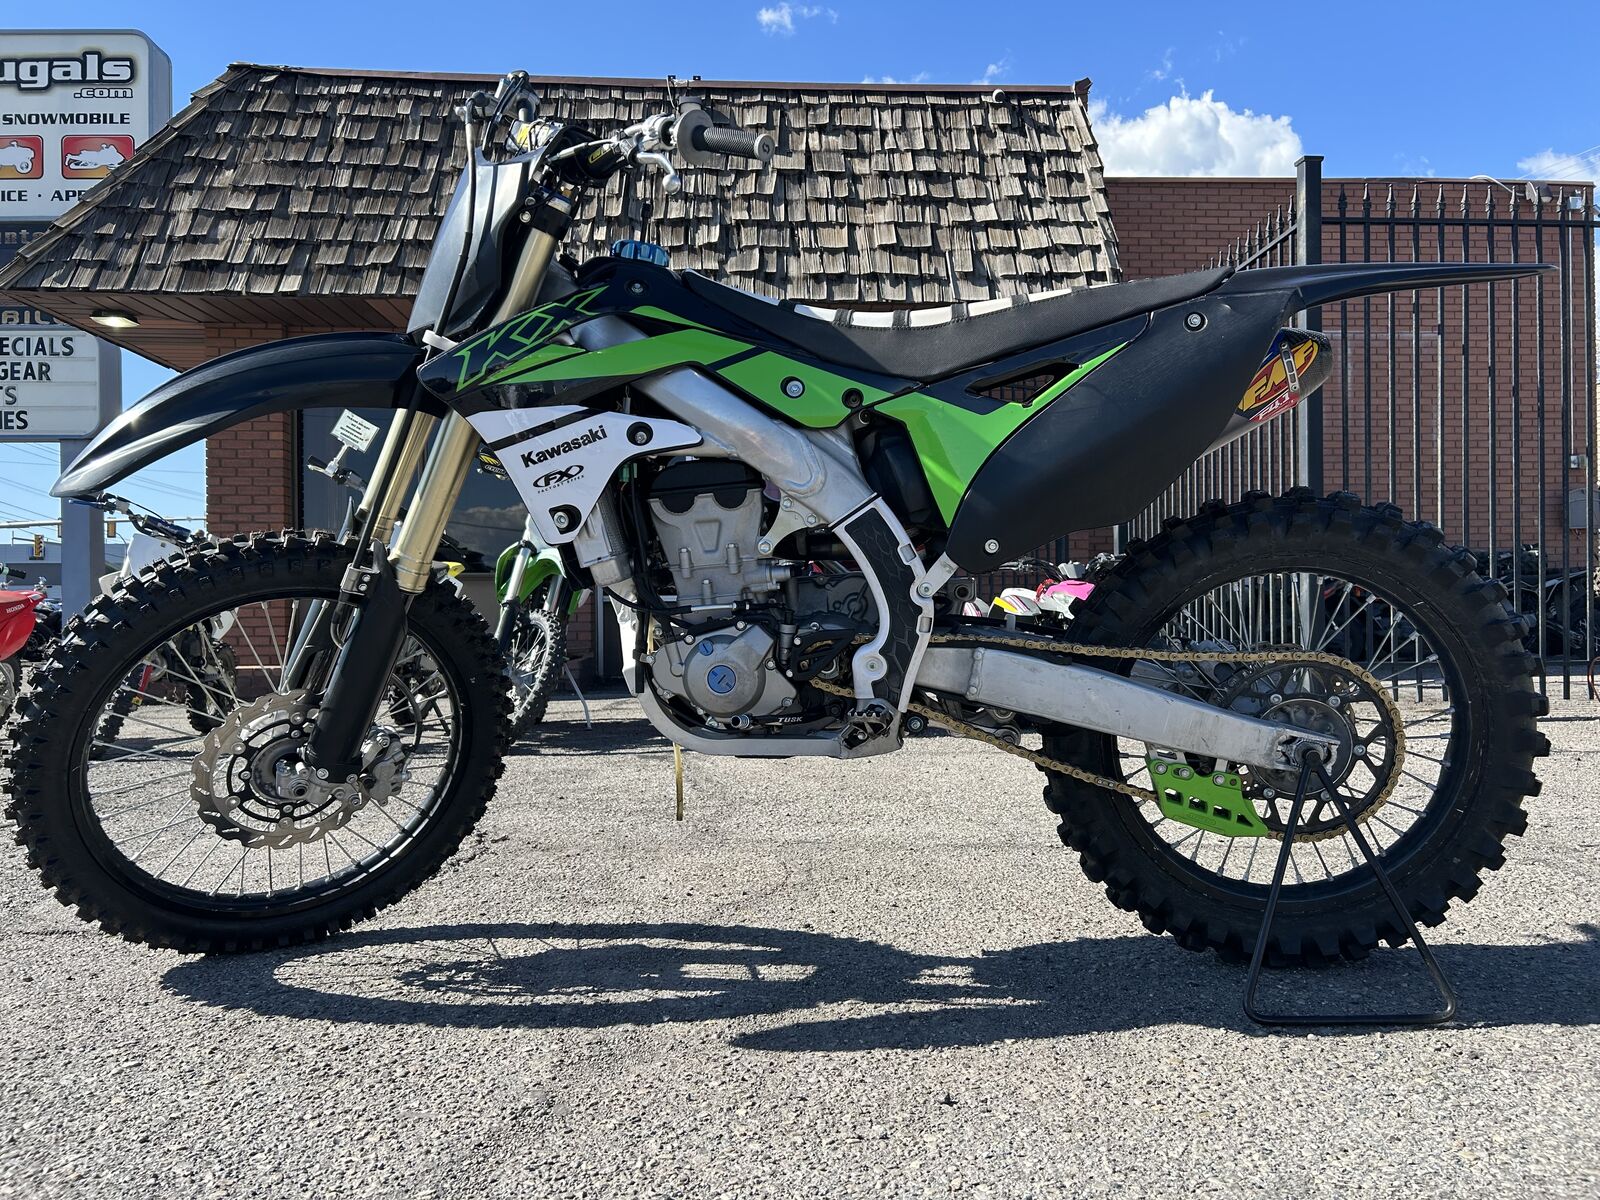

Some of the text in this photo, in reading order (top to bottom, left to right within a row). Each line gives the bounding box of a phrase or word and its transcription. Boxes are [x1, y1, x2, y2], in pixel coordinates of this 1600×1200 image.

[74, 87, 133, 98] .com
[2, 113, 131, 125] SNOWMOBILE
[0, 336, 74, 357] ECIALS
[0, 361, 51, 381] GEAR
[520, 425, 608, 468] Kawasaki
